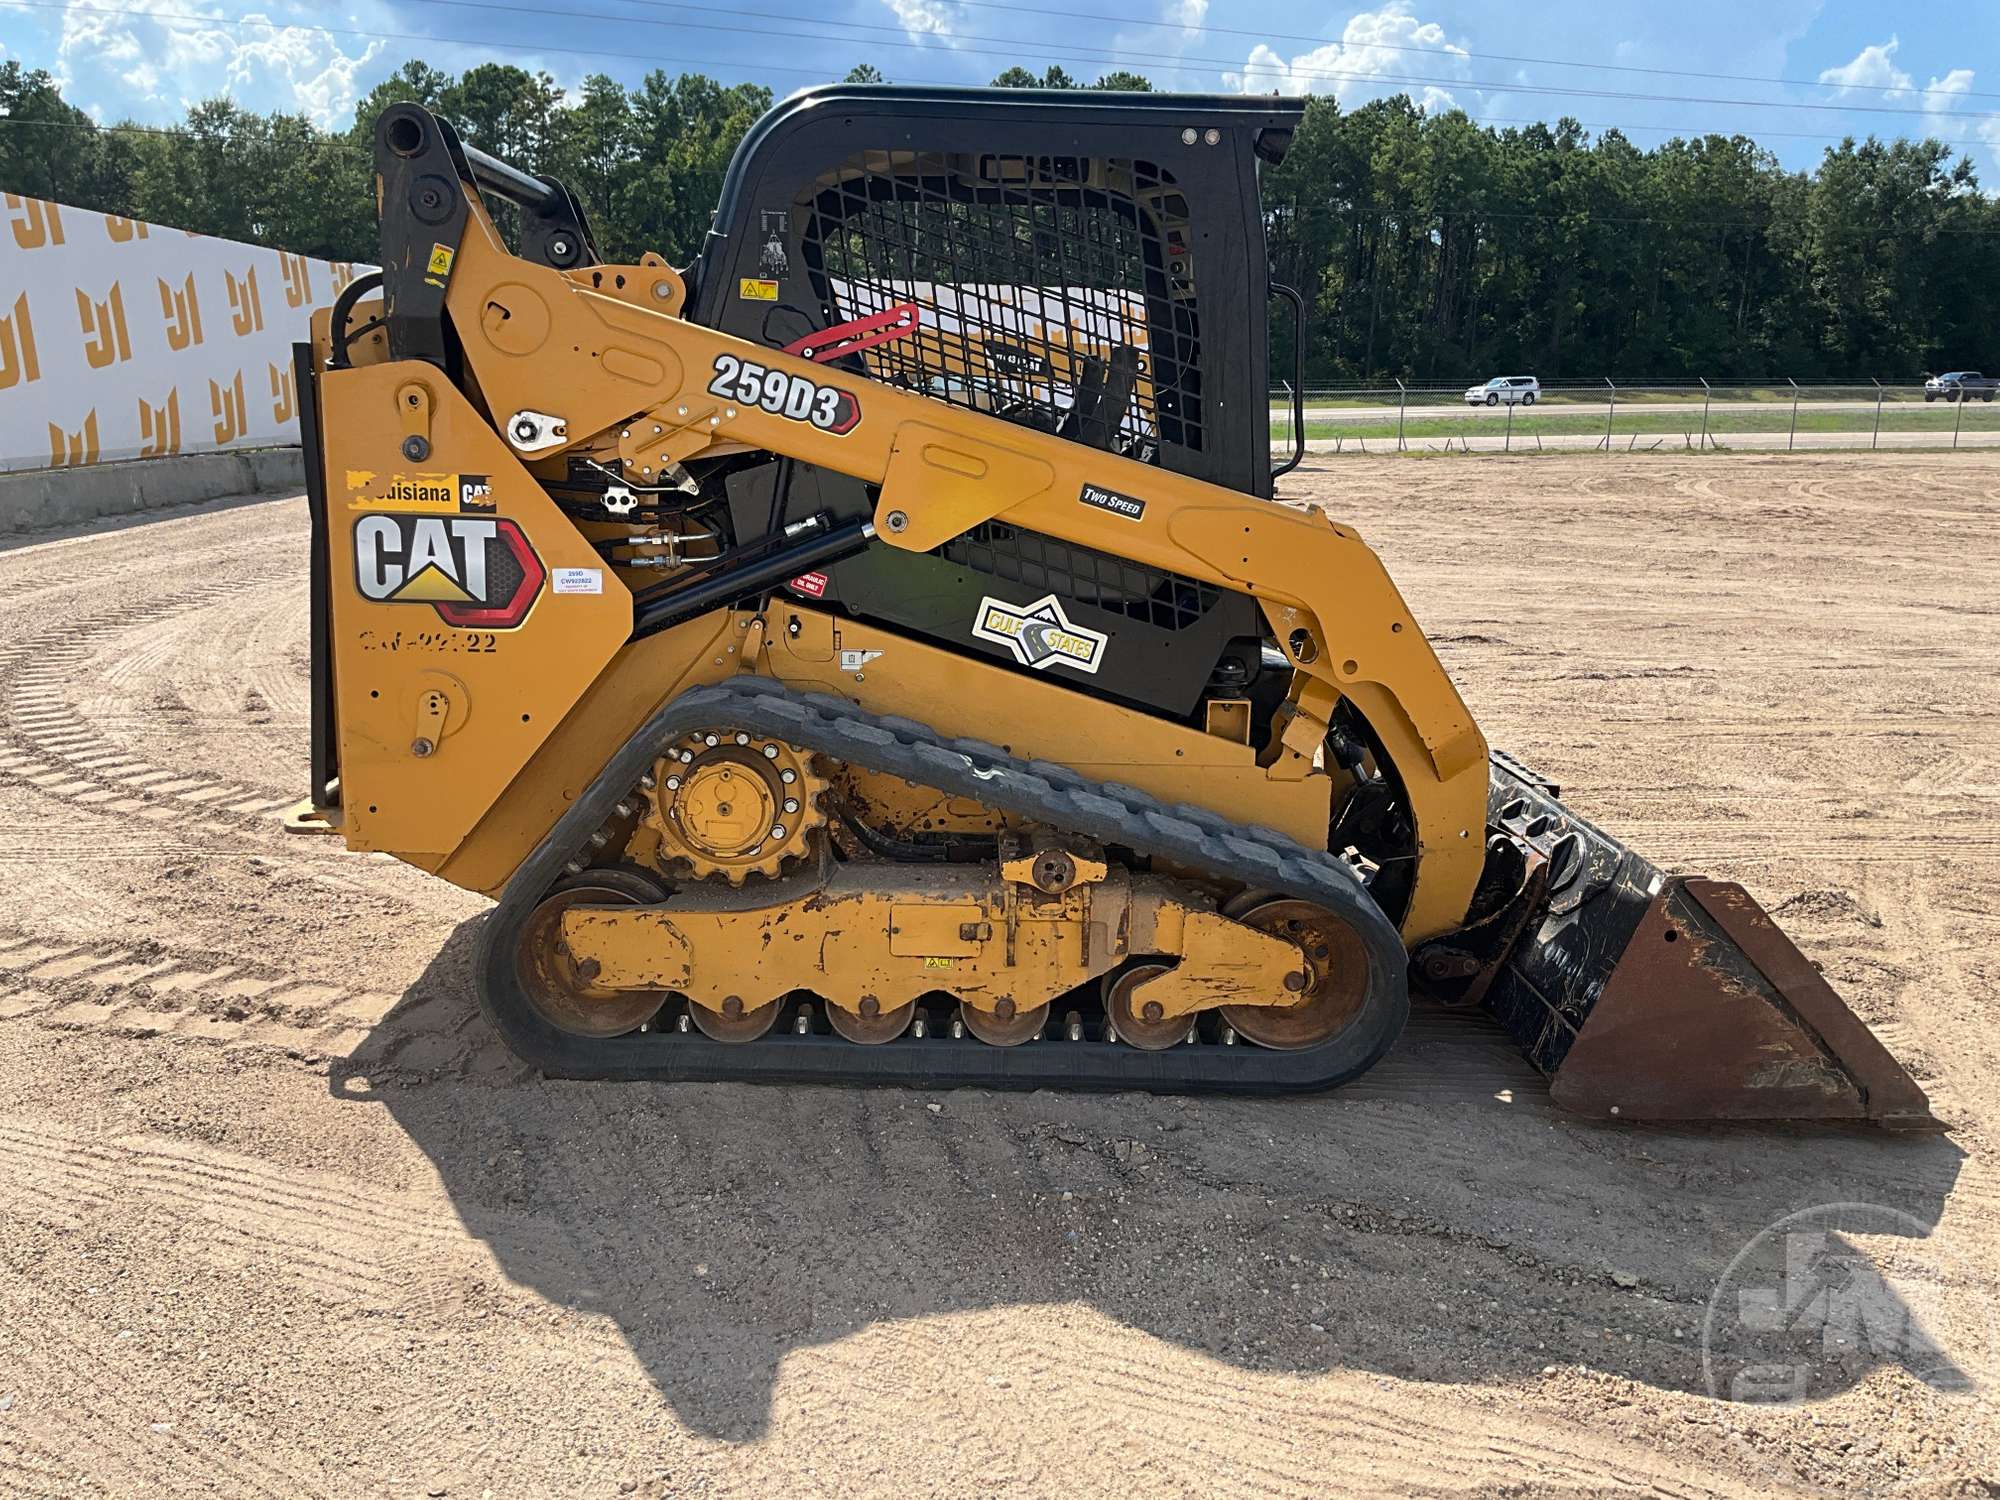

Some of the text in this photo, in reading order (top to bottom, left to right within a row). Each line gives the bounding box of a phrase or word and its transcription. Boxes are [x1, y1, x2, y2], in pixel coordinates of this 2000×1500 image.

[710, 355, 839, 427] 259D3
[1085, 488, 1140, 515] TWO SPEED
[355, 514, 496, 602] CAT
[988, 611, 1092, 659] GULF STATES
